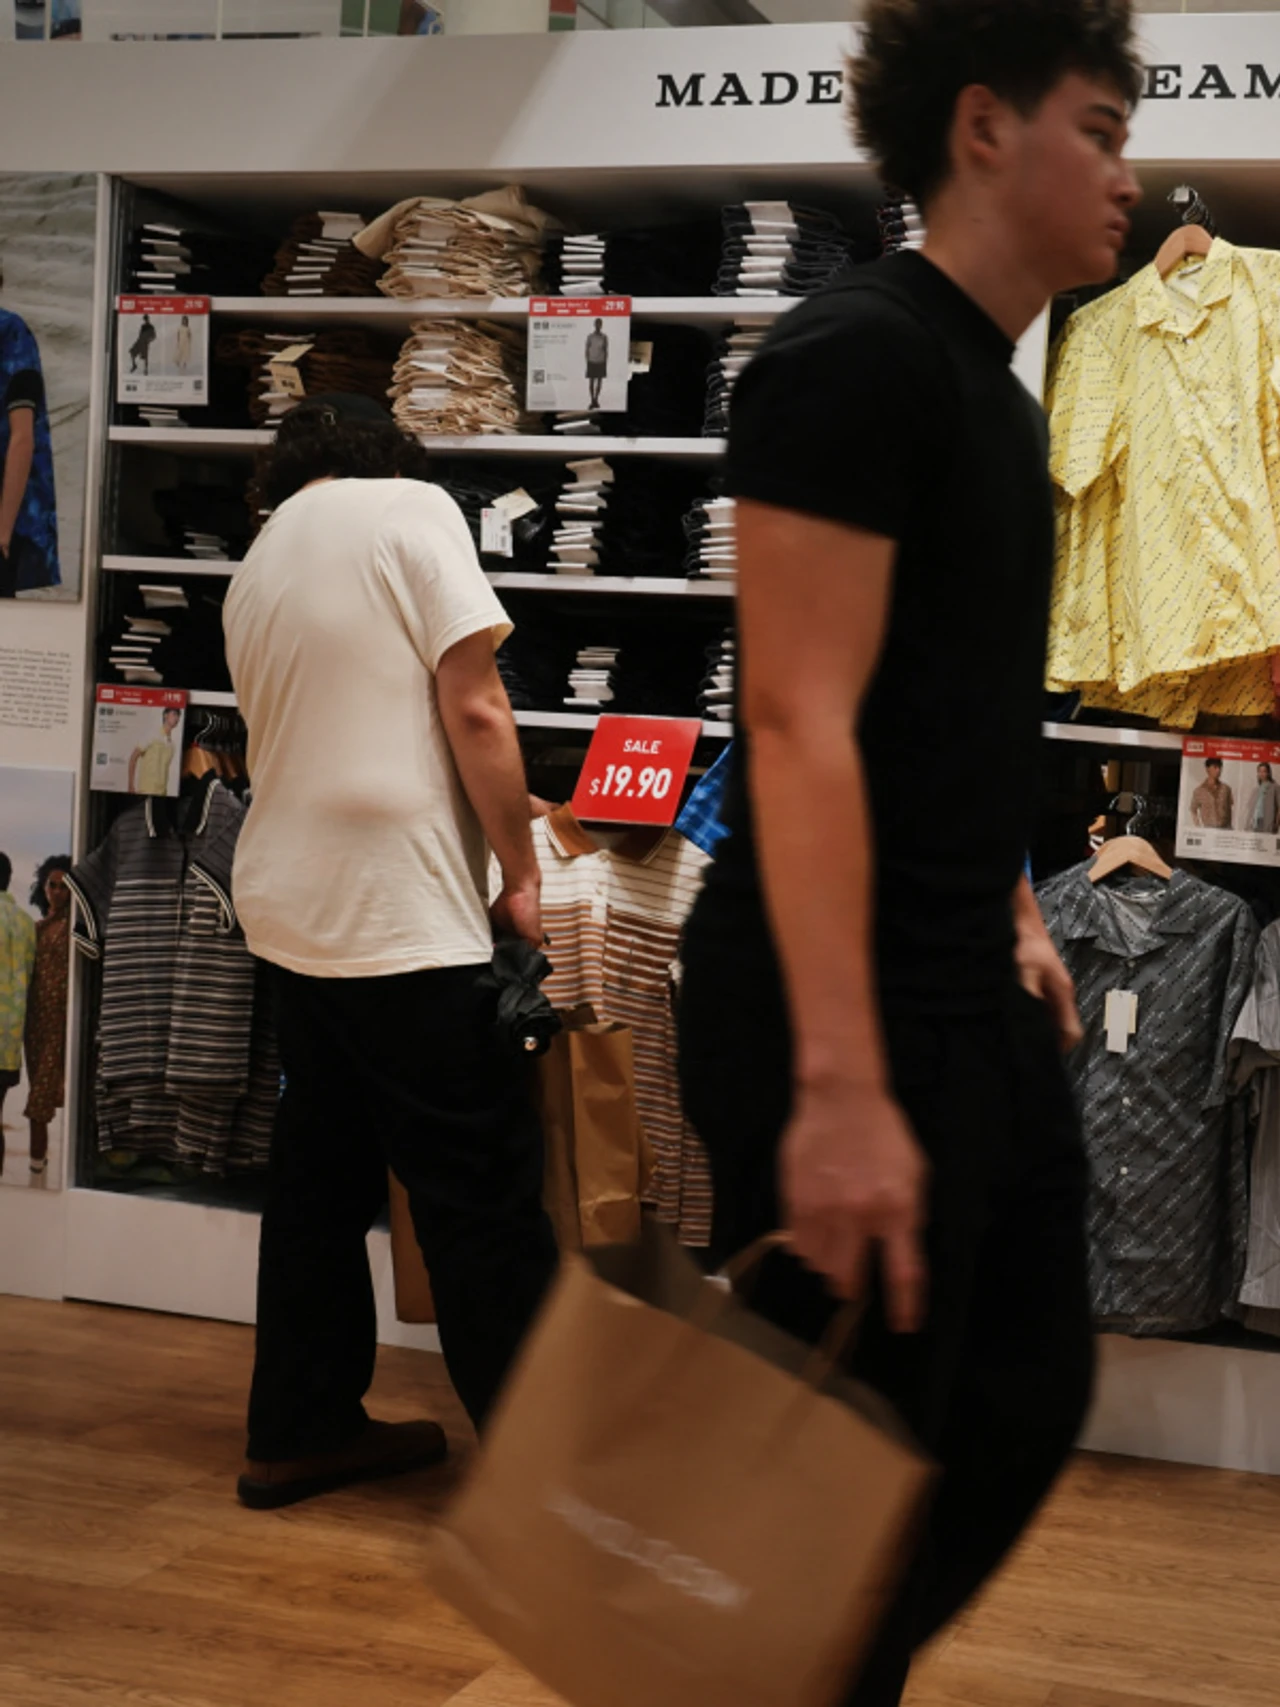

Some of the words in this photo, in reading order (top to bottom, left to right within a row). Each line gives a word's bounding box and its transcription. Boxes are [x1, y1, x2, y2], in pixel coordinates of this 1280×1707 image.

[655, 71, 844, 107] MADE
[622, 738, 662, 755] SALE
[588, 763, 673, 800] $19.90
